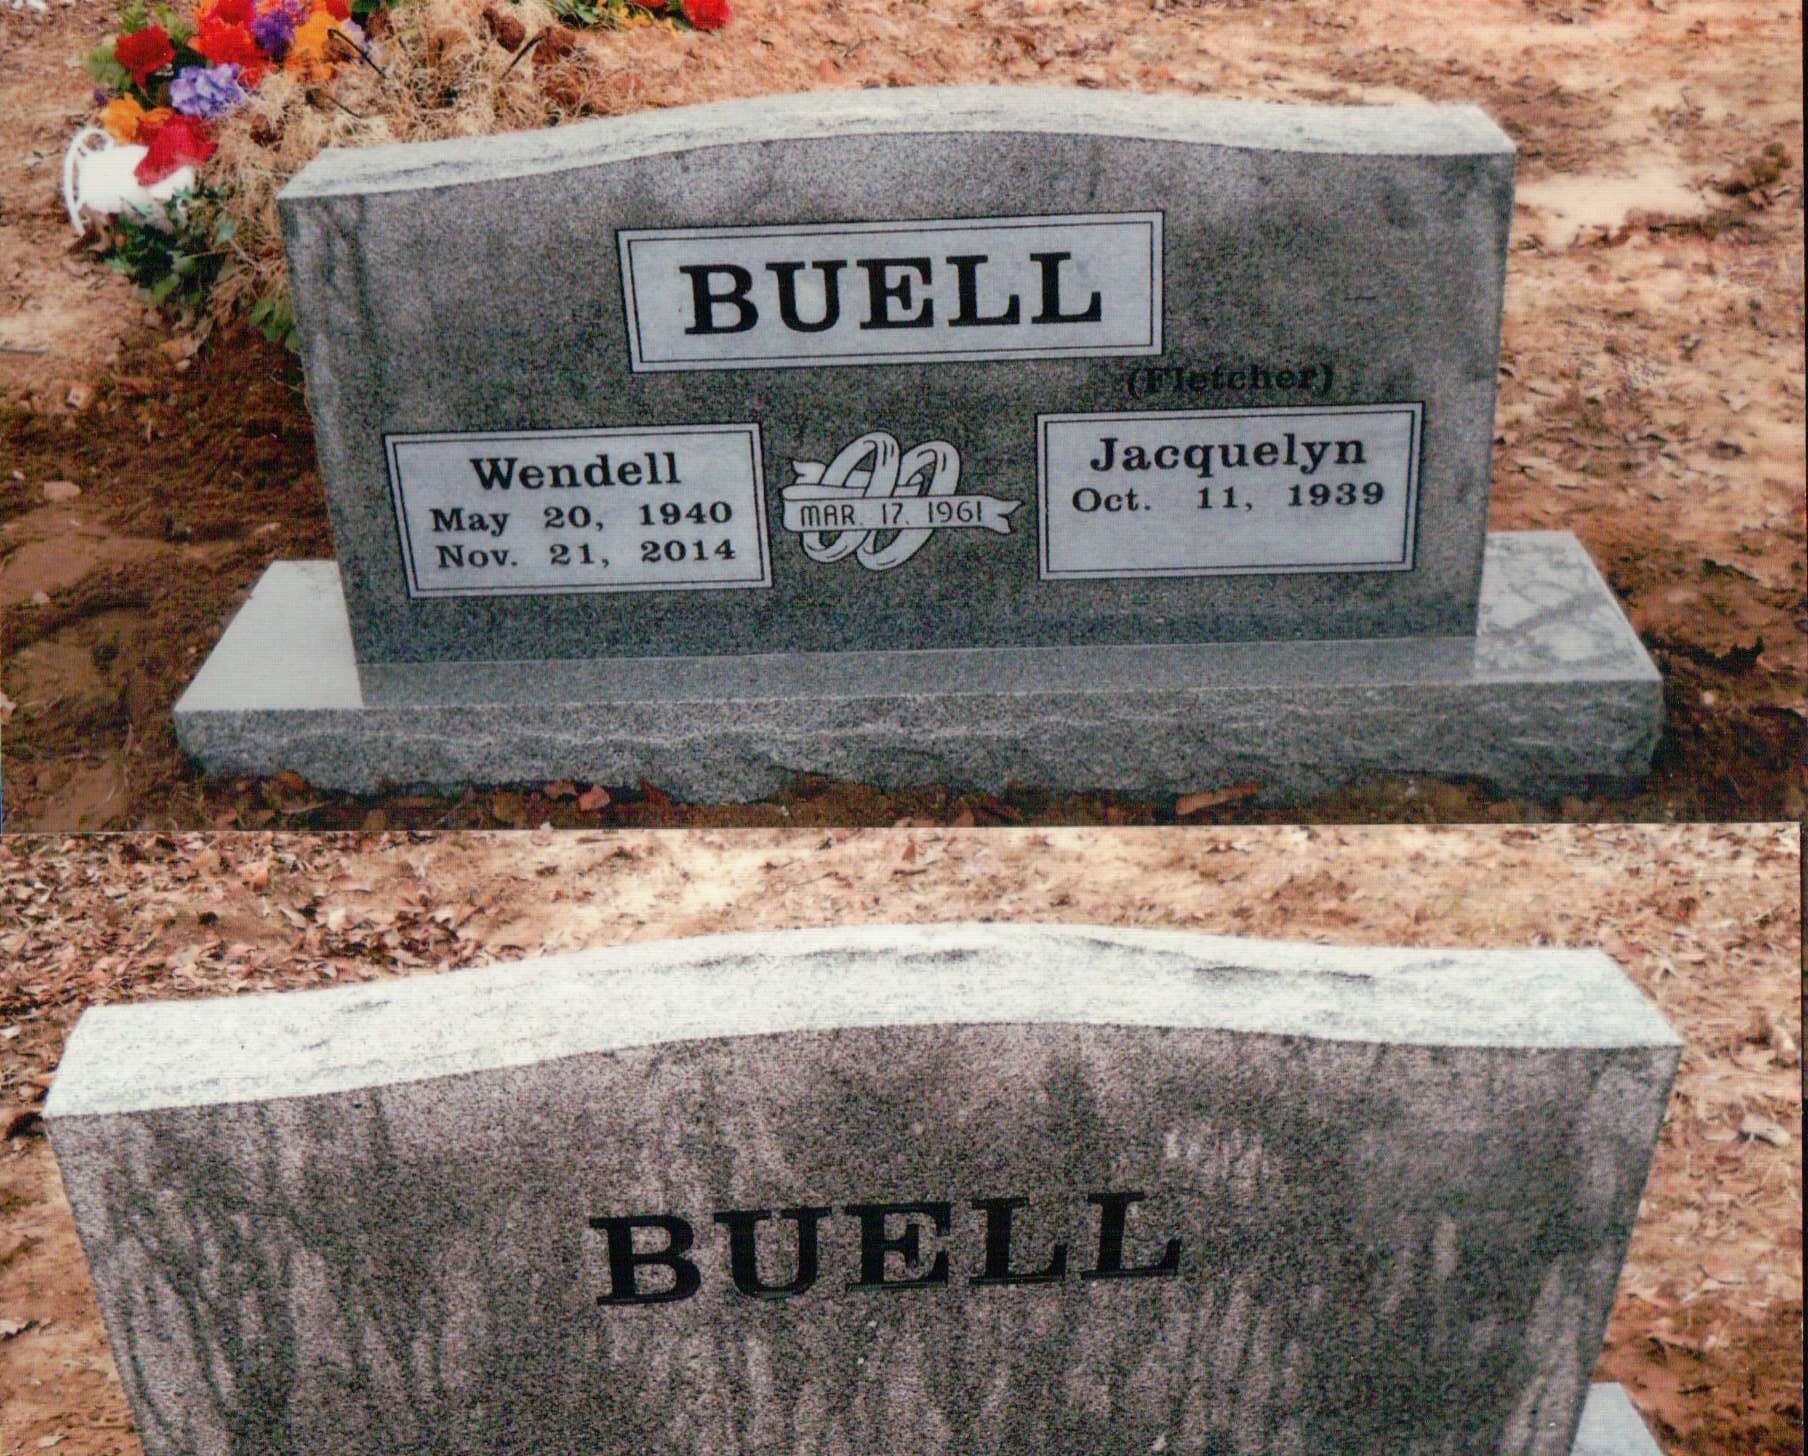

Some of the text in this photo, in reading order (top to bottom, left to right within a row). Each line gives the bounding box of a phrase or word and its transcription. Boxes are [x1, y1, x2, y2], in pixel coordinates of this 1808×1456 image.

[679, 251, 1102, 335] BUELL
[1128, 363, 1334, 398] (Fletcher)
[469, 451, 682, 490] Wendell
[1090, 432, 1367, 478] Jacquelyn
[928, 501, 982, 523] 1961
[1072, 481, 1385, 513] Oct. 11, 1939
[429, 500, 733, 537] May 20, 1940
[435, 539, 736, 570] Nov. 21, 2014
[589, 1191, 1183, 1306] BUELL
